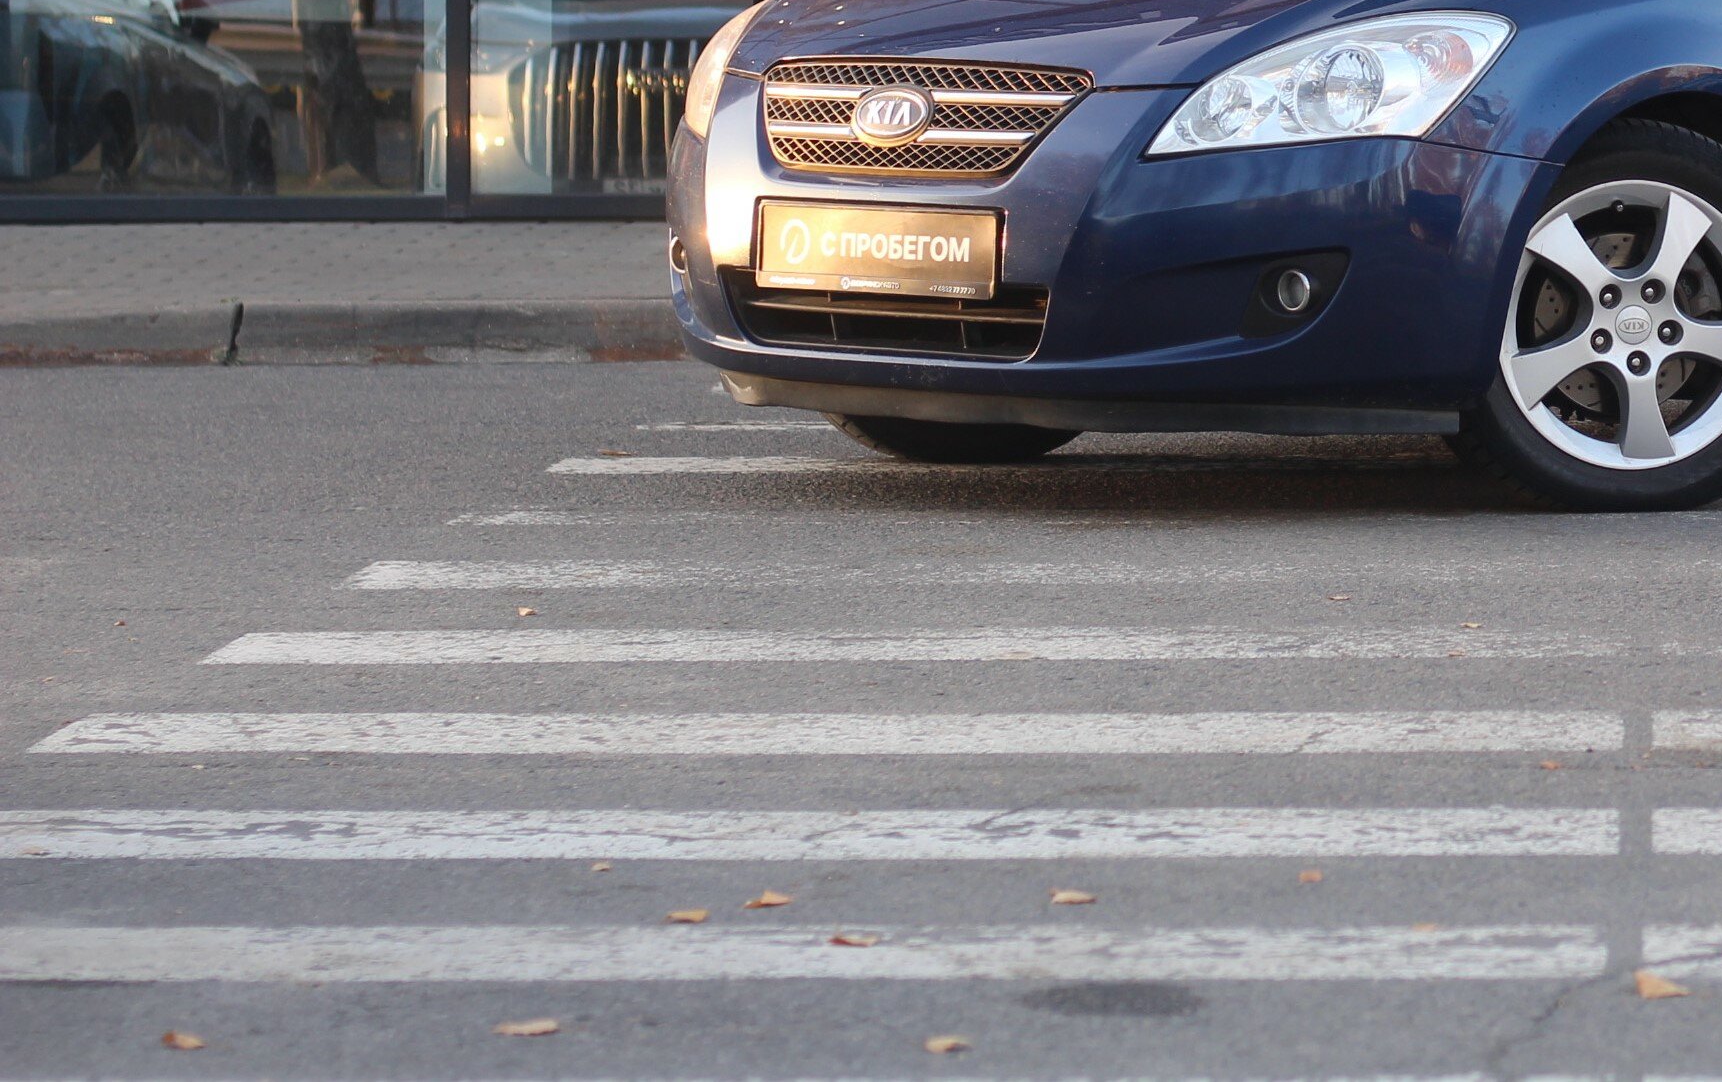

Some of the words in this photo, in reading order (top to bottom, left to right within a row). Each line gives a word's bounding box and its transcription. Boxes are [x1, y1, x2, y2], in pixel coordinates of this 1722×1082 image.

[866, 100, 912, 126] KIA
[820, 232, 837, 258] С
[840, 231, 971, 263] ПРОБЕГОМ
